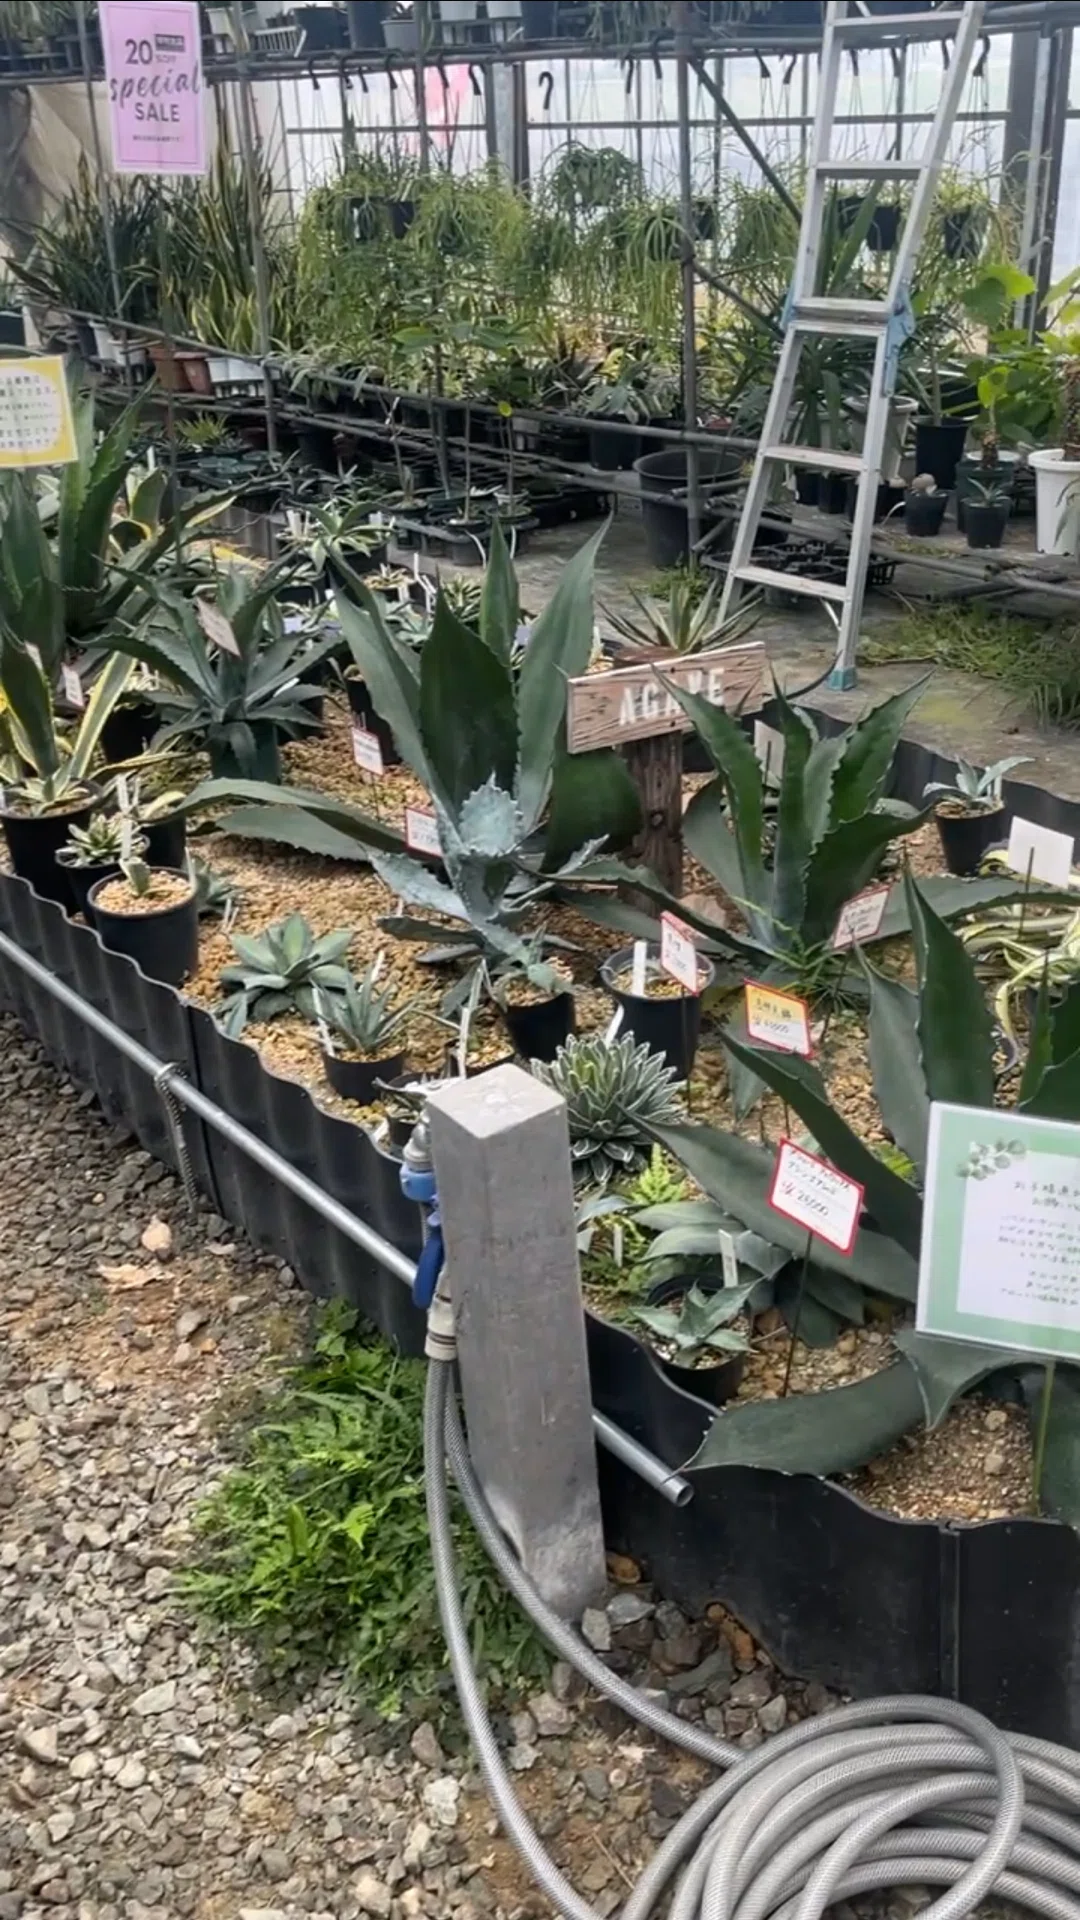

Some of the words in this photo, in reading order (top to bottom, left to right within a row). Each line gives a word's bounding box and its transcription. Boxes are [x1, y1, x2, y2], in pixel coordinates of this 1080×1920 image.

[125, 38, 153, 65] 20
[109, 60, 200, 109] special
[134, 102, 180, 122] SALE
